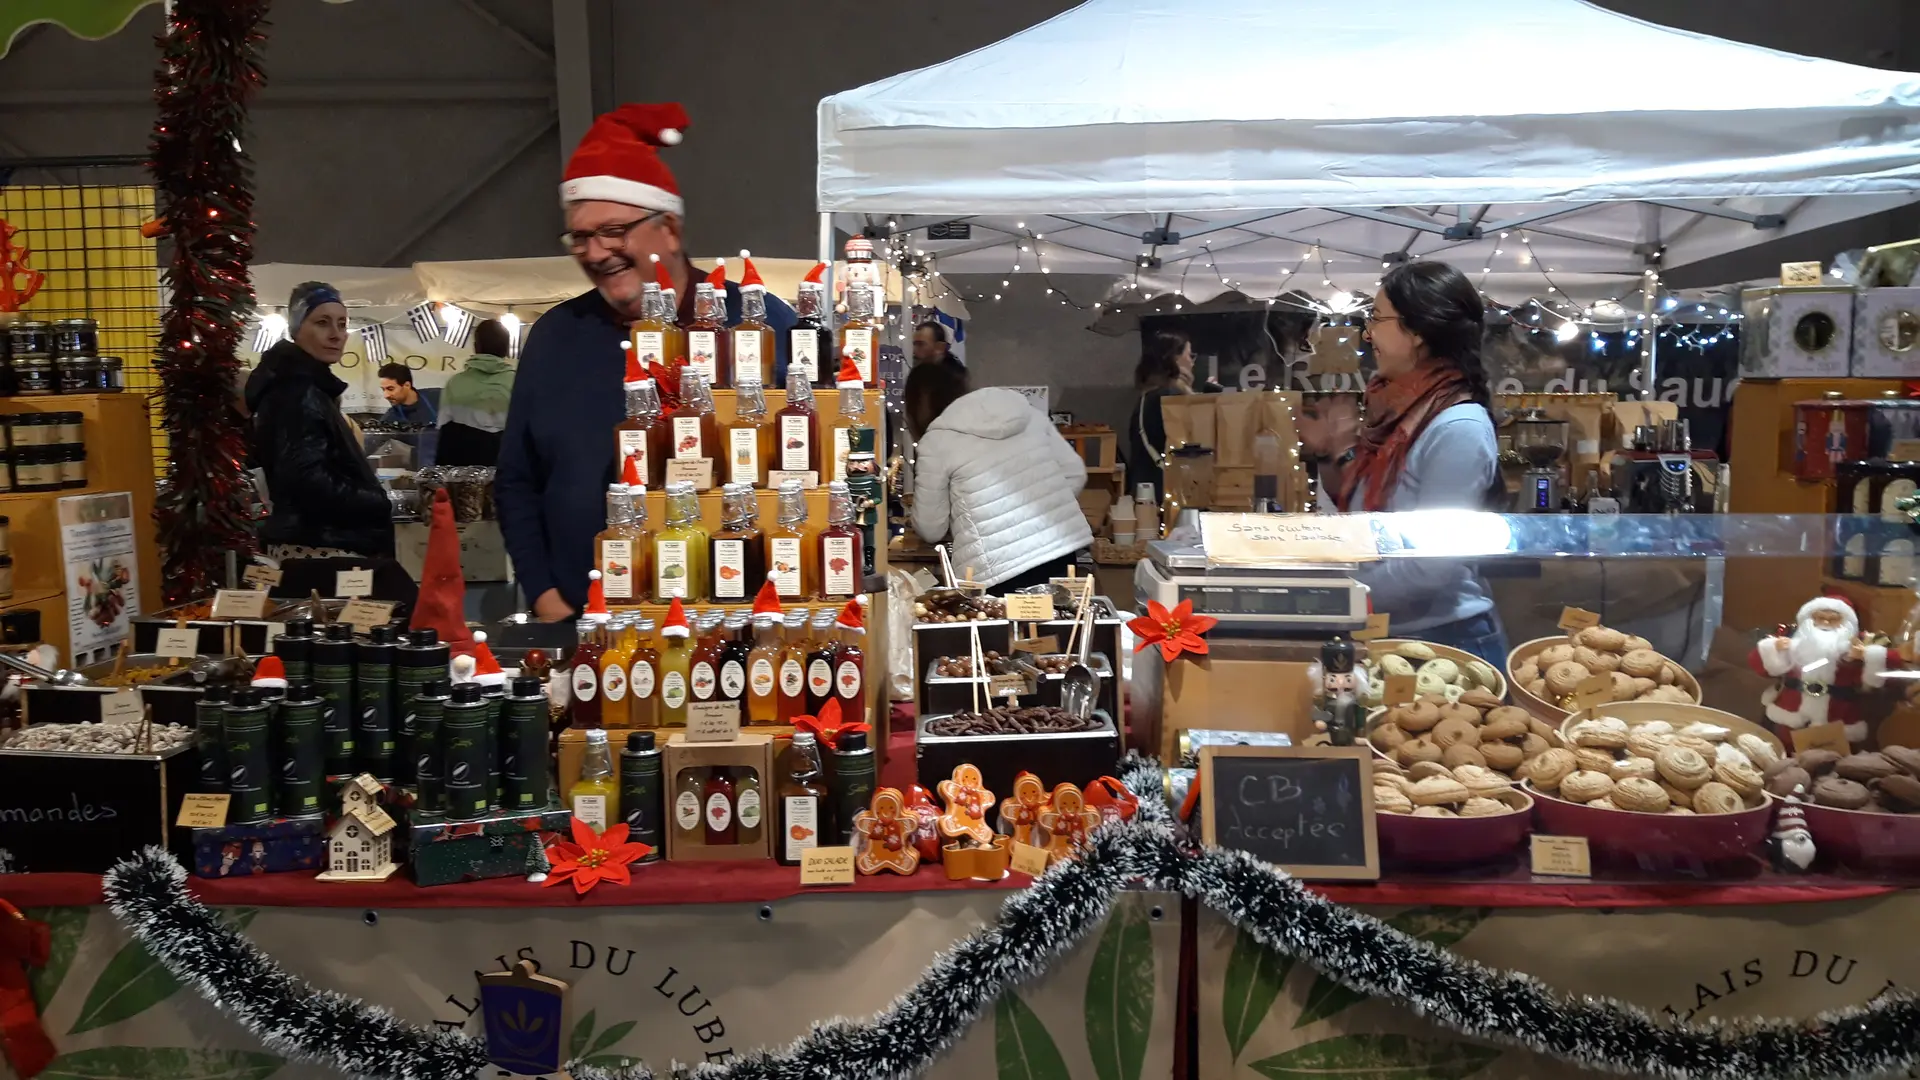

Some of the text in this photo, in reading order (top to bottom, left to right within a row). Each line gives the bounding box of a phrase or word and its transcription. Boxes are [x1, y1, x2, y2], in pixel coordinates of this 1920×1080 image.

[1227, 523, 1322, 533] Sans Gluten
[1252, 534, 1286, 542] Sans
[1239, 775, 1302, 806] CB
[0, 792, 117, 822] mandes
[569, 940, 636, 976] DU
[1789, 950, 1858, 985] DU
